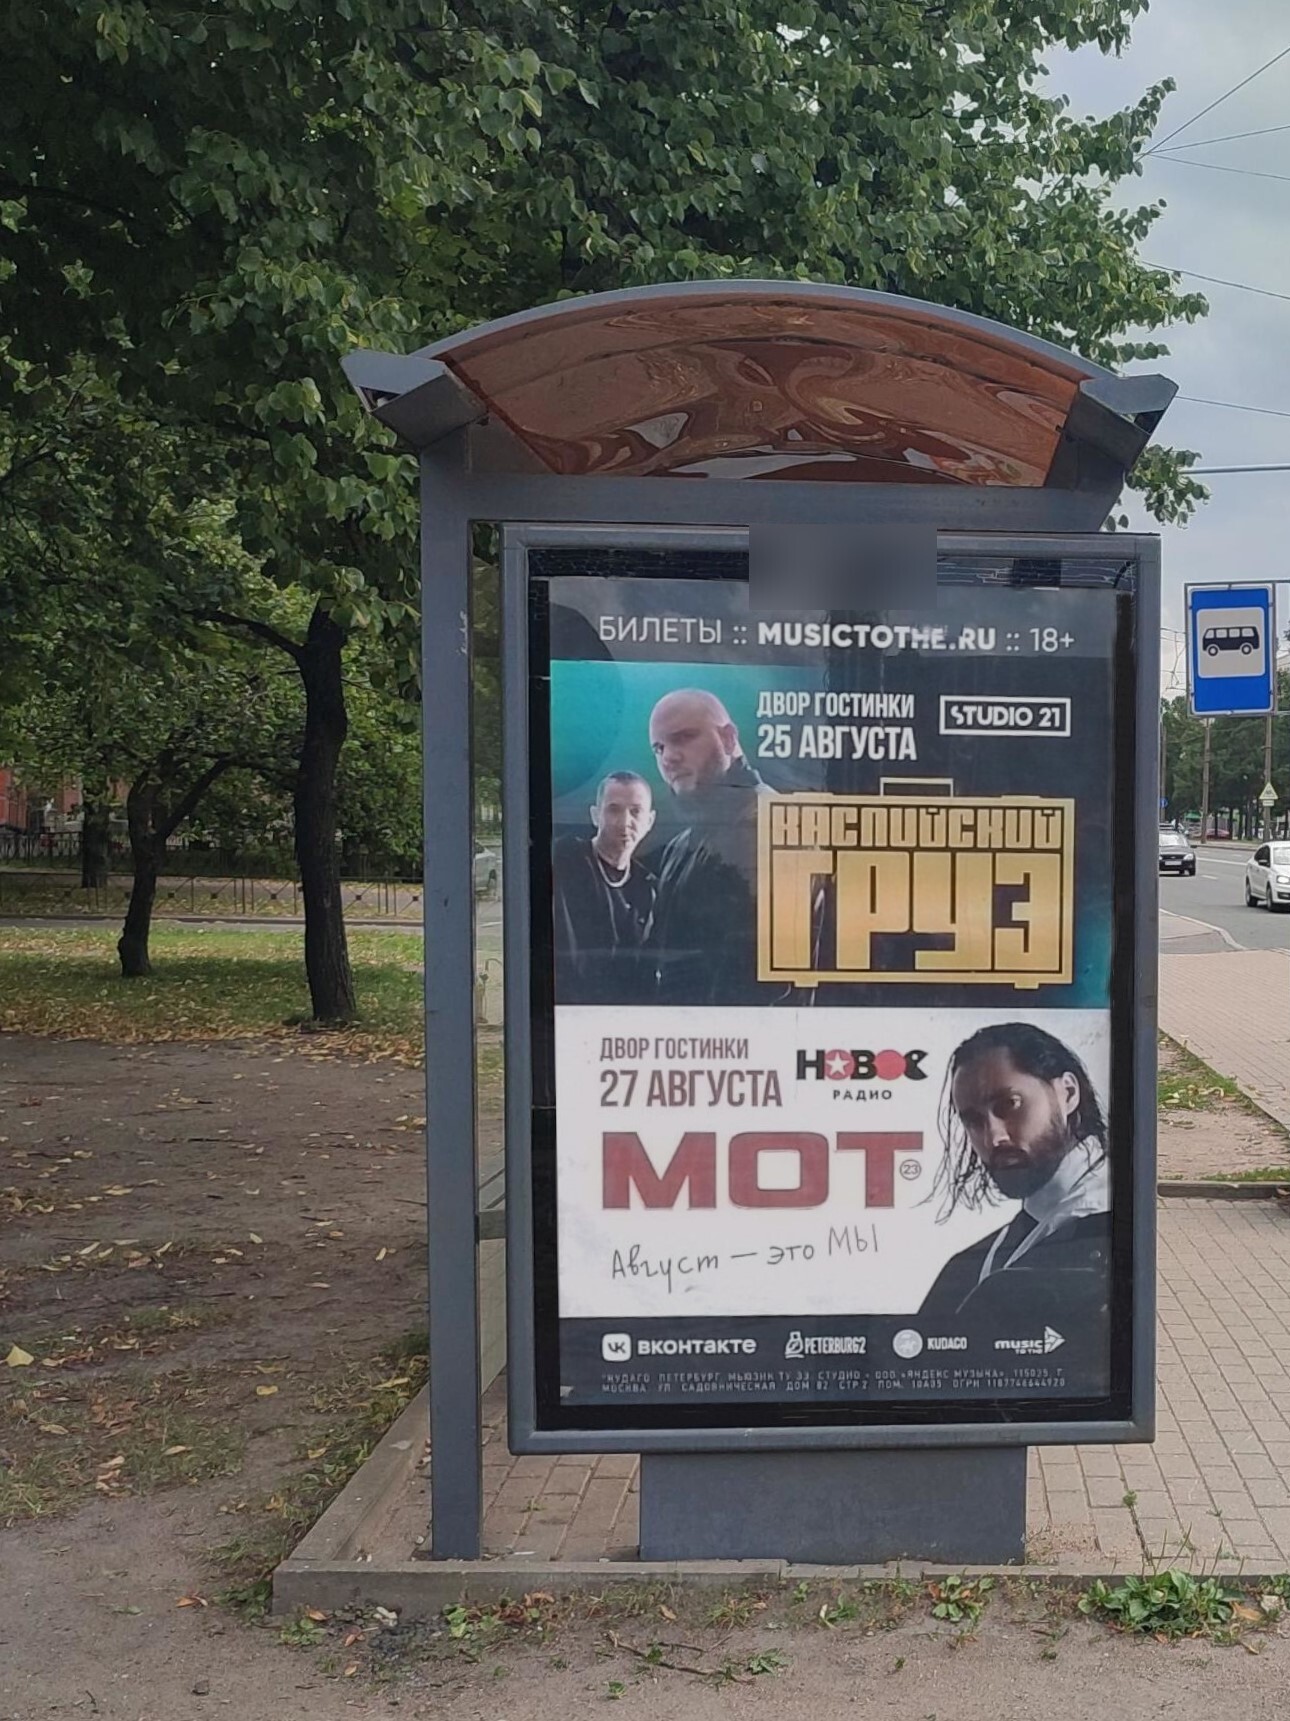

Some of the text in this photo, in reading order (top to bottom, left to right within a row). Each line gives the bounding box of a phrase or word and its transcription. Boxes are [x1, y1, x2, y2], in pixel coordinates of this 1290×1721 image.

[600, 616, 722, 644] БИЛЕТЫ
[757, 622, 997, 651] MUSICTOTHE.RU
[1029, 627, 1076, 653] 18+
[756, 691, 916, 719] ДВОР ГОСТИНКИ
[950, 705, 1062, 728] STUDIO 21
[757, 724, 918, 761] 25 АВГУСТА
[772, 805, 1062, 849] КАСПИЙСКИЙ
[772, 850, 1062, 971] ГРУЗ
[600, 1037, 749, 1062] ДВОР ГОСТИНКИ
[600, 1069, 783, 1108] 27 АВГУСТА
[832, 1089, 893, 1102] РАДИО
[602, 1131, 924, 1210] МОТ
[612, 1244, 719, 1294] Август
[766, 1245, 815, 1265] это
[927, 1336, 968, 1351] KUDAGO
[658, 1371, 721, 1382] ПЕТЕРБУРГ
